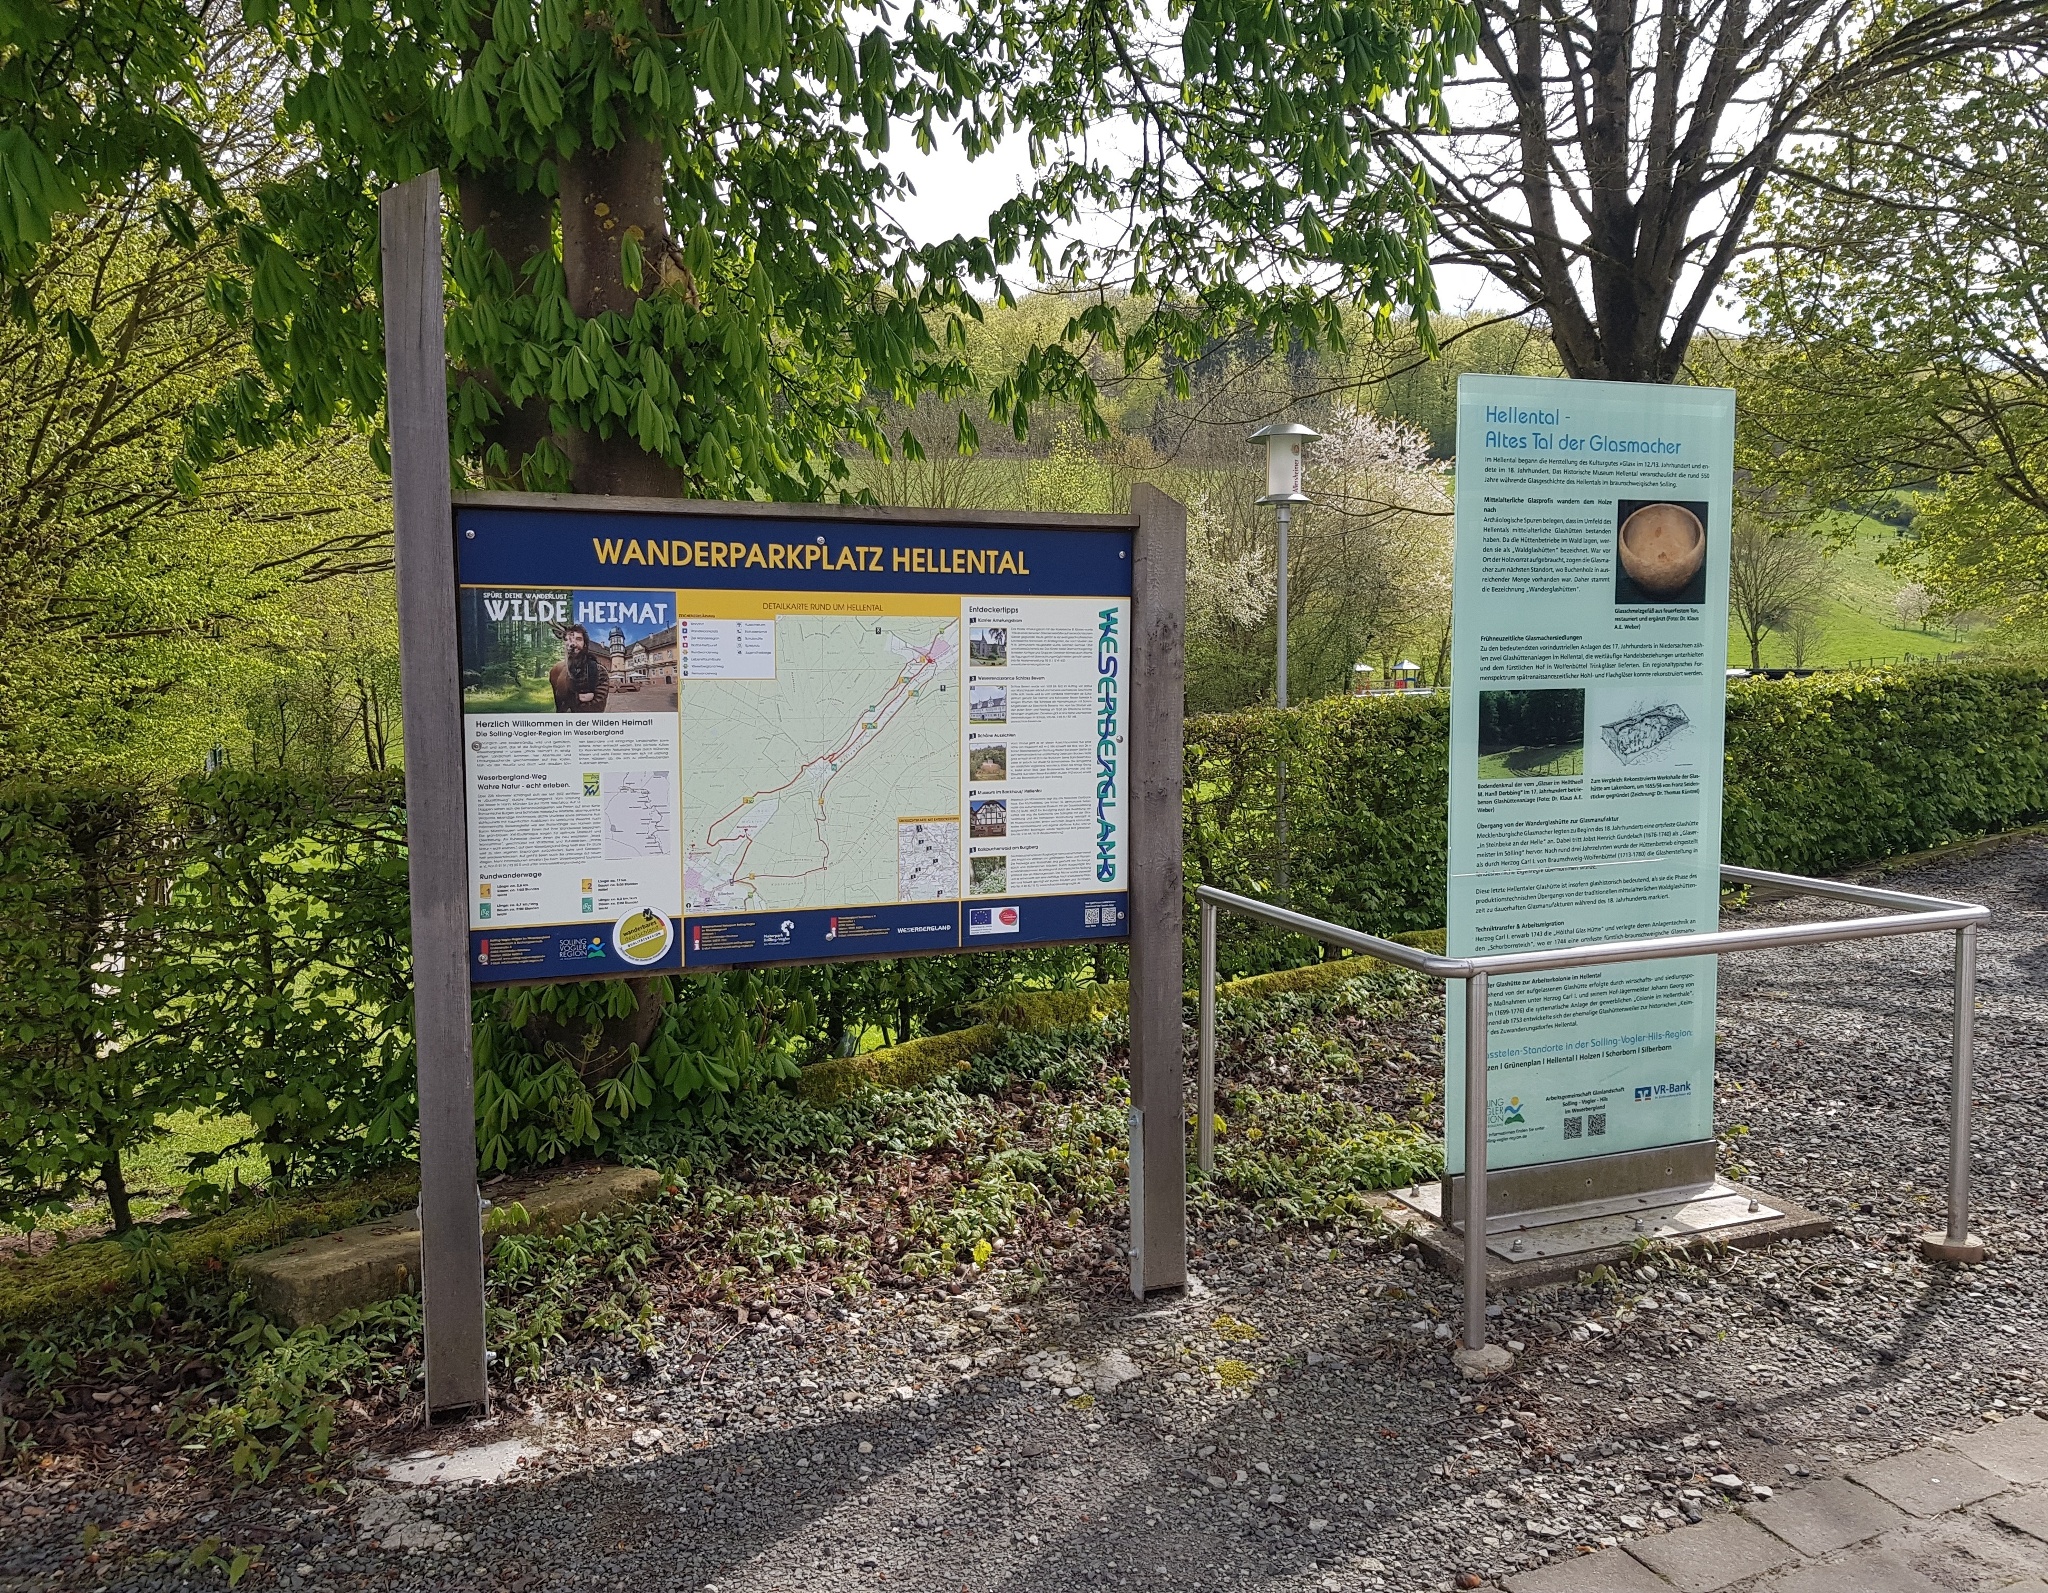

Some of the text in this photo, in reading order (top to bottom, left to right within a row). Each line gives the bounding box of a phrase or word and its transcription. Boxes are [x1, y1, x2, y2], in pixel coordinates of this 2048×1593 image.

[1486, 406, 1559, 425] Hellental
[1486, 431, 1682, 454] Altes Tal der Glasmacher
[1527, 497, 1553, 505] Glasprofis
[1484, 516, 1523, 524] Archäologische
[1523, 516, 1542, 525] Spuren
[1542, 517, 1565, 525] belegen,
[593, 538, 1030, 575] WANDERPARKPLATZ HELLENTAL
[484, 600, 667, 625] WILDE HEIMAT
[1524, 634, 1582, 642] Glasmachersiedlungen
[476, 720, 509, 728] Herzlich
[574, 729, 624, 737] Weserbergland
[1097, 607, 1119, 882] WESERBERGLAND
[477, 774, 547, 782] Weserbergland-Weg
[1477, 822, 1502, 831] Übergang
[1524, 818, 1568, 828] Wanderglashütte
[1579, 815, 1619, 824] Glasmanufaktur
[480, 872, 542, 880] Rundwanderwege
[623, 921, 656, 936] wanderbares
[898, 924, 951, 934] WESERBERGLAND
[1475, 923, 1514, 932] Techniktransfer
[1521, 920, 1564, 930] Arbeitsmigration
[1565, 1040, 1573, 1050] in
[1574, 1038, 1589, 1049] der
[1504, 1057, 1541, 1071] Grünenplan
[1546, 1054, 1574, 1065] Hellental
[1579, 1051, 1600, 1061] Holzen
[1605, 1047, 1636, 1058] Schorborn
[1641, 1043, 1672, 1054] Silberborn
[1654, 1081, 1691, 1094] VR-Bank
